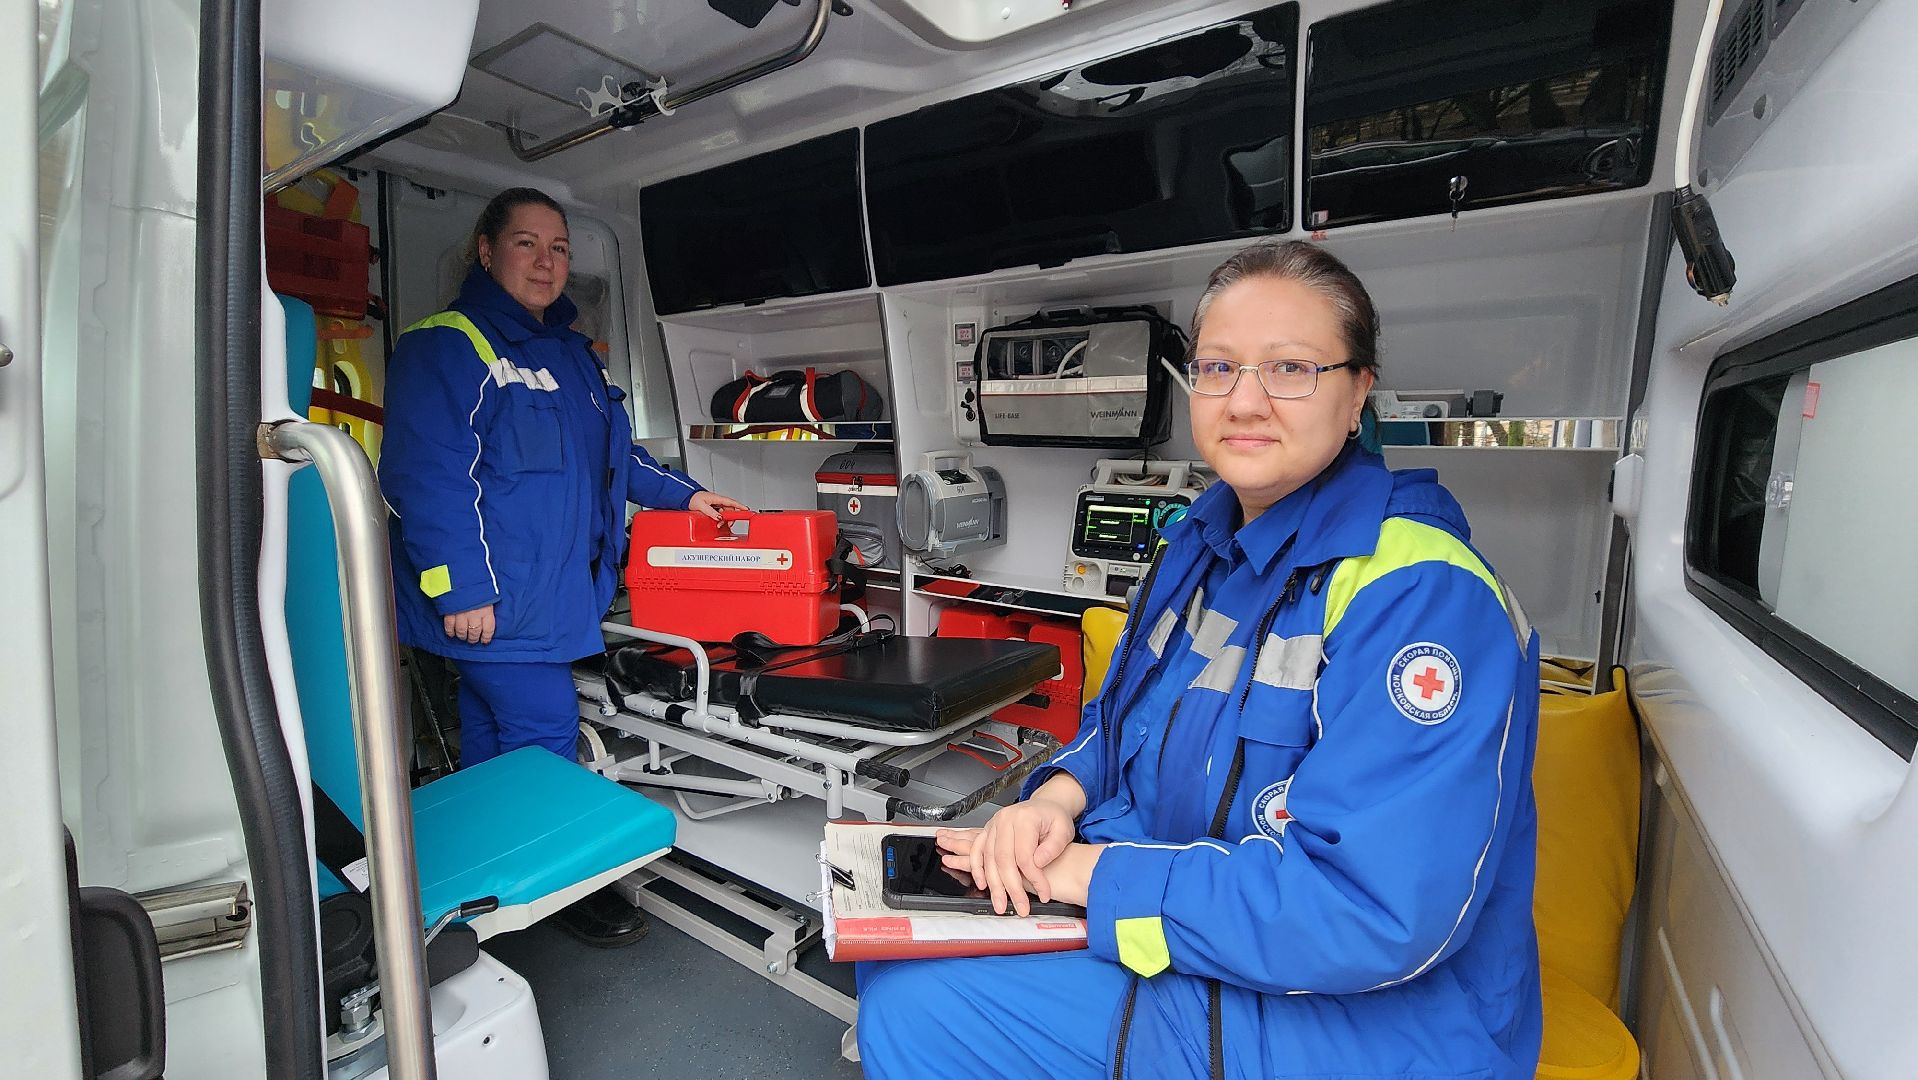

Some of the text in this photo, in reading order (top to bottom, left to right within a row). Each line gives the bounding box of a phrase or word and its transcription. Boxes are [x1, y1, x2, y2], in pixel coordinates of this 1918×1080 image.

[1090, 407, 1138, 420] WEINMANN
[681, 553, 735, 562] АКУШЕРСКИЙ
[1398, 647, 1460, 681] СКОРАЯ ПОМОЩЬ
[1392, 674, 1431, 720] МОСКОВСКАЯ
[1258, 786, 1285, 809] СКОРАЯ
